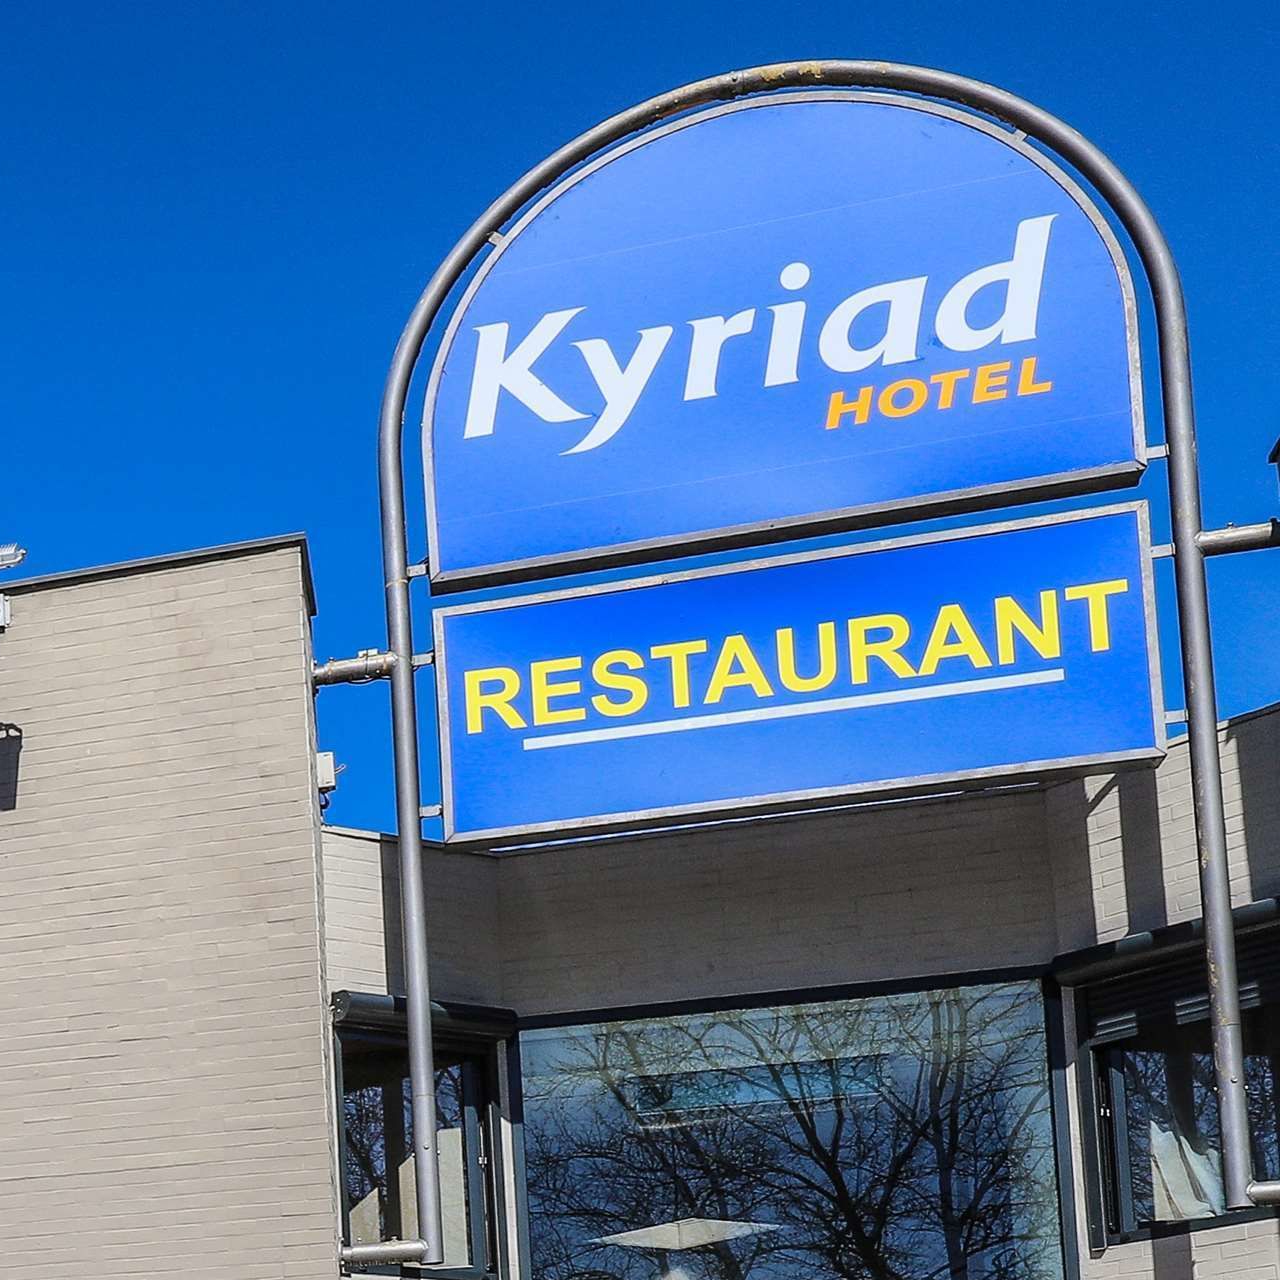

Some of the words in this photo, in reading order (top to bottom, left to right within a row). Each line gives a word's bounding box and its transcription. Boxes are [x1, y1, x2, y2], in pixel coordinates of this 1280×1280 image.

[462, 213, 1059, 456] Kyriad
[824, 356, 1053, 430] HOTEL
[463, 579, 1129, 734] RESTAURANT
